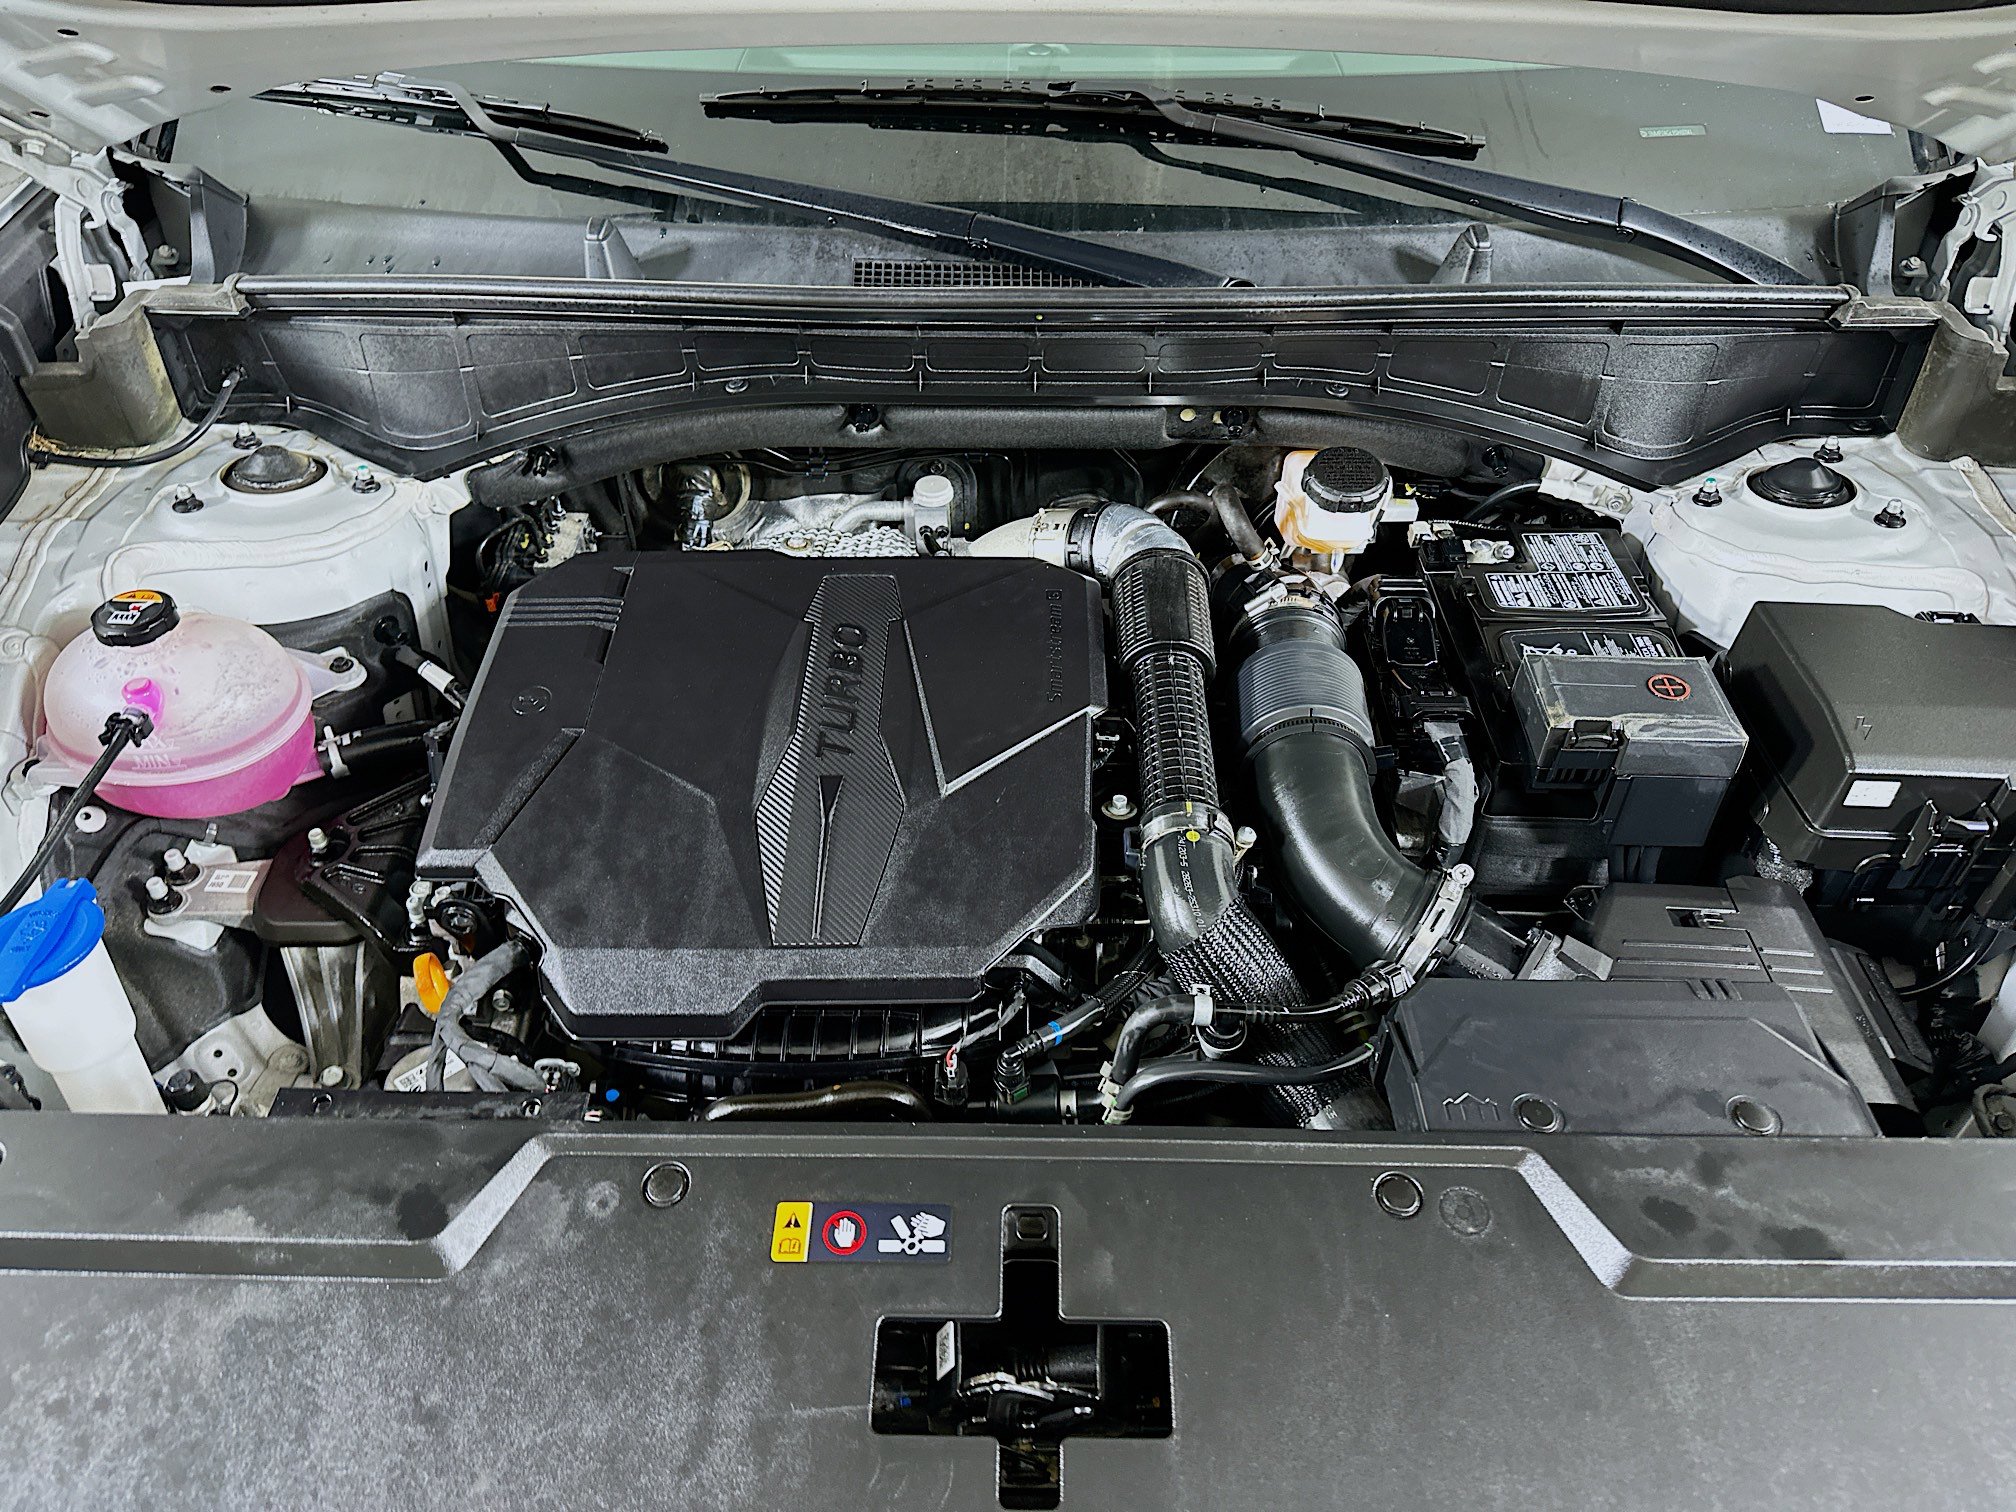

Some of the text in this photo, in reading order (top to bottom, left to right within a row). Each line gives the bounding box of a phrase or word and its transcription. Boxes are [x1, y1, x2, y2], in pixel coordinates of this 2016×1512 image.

[816, 624, 867, 758] TURBO
[1046, 603, 1062, 703] Smartstream
[134, 754, 171, 769] MIN
